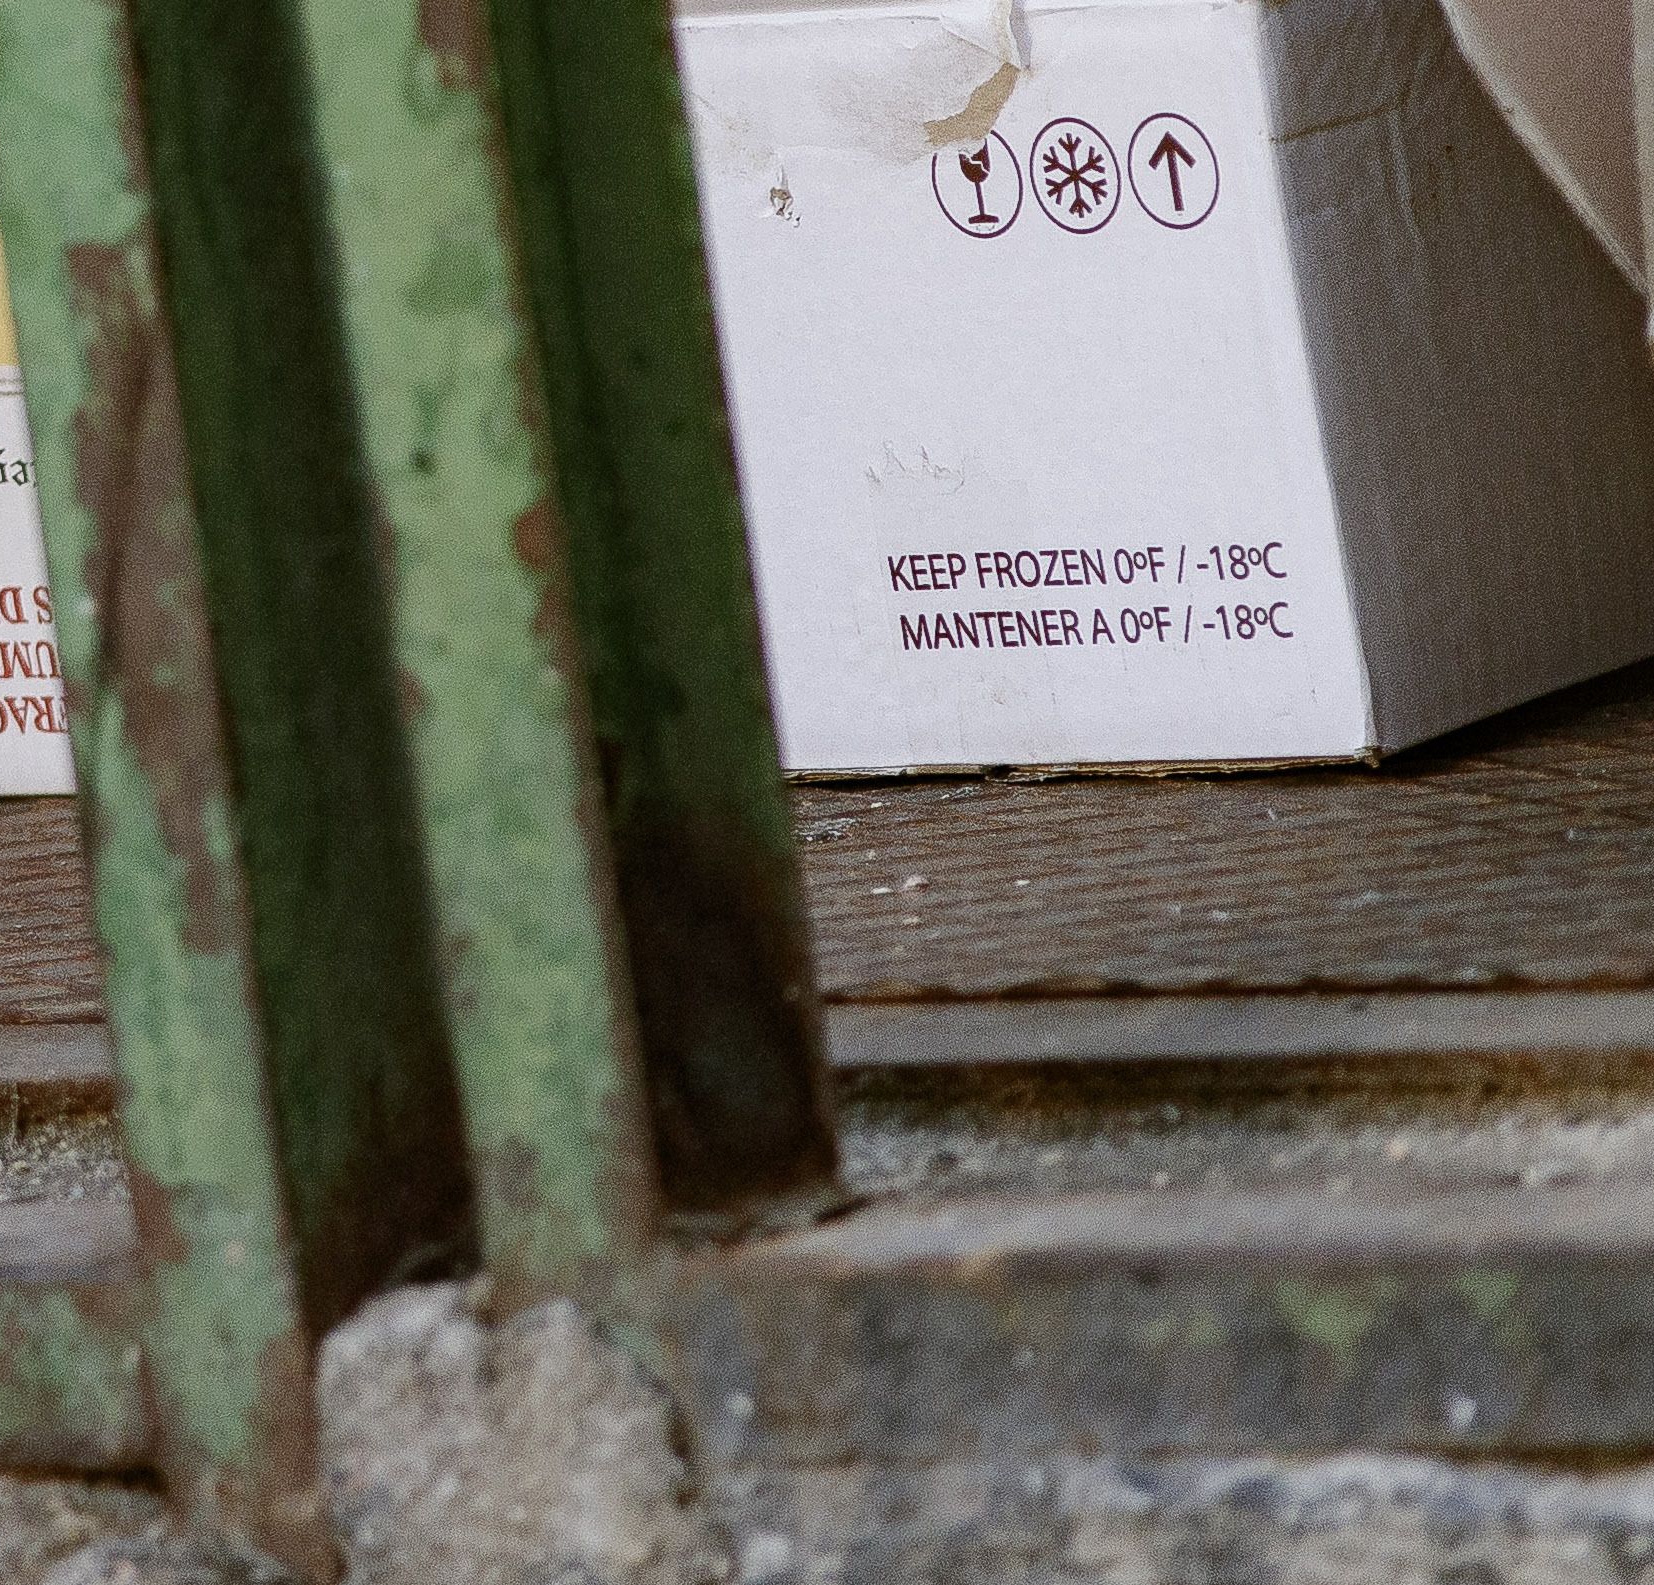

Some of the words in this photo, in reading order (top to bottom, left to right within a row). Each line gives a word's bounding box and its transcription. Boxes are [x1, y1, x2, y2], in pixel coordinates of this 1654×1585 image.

[888, 552, 966, 591] KEEP
[975, 548, 1107, 588] FROZEN
[1178, 545, 1187, 584] /
[900, 609, 1084, 650] MANTENER
[1093, 608, 1115, 645] A
[1184, 605, 1193, 643] /
